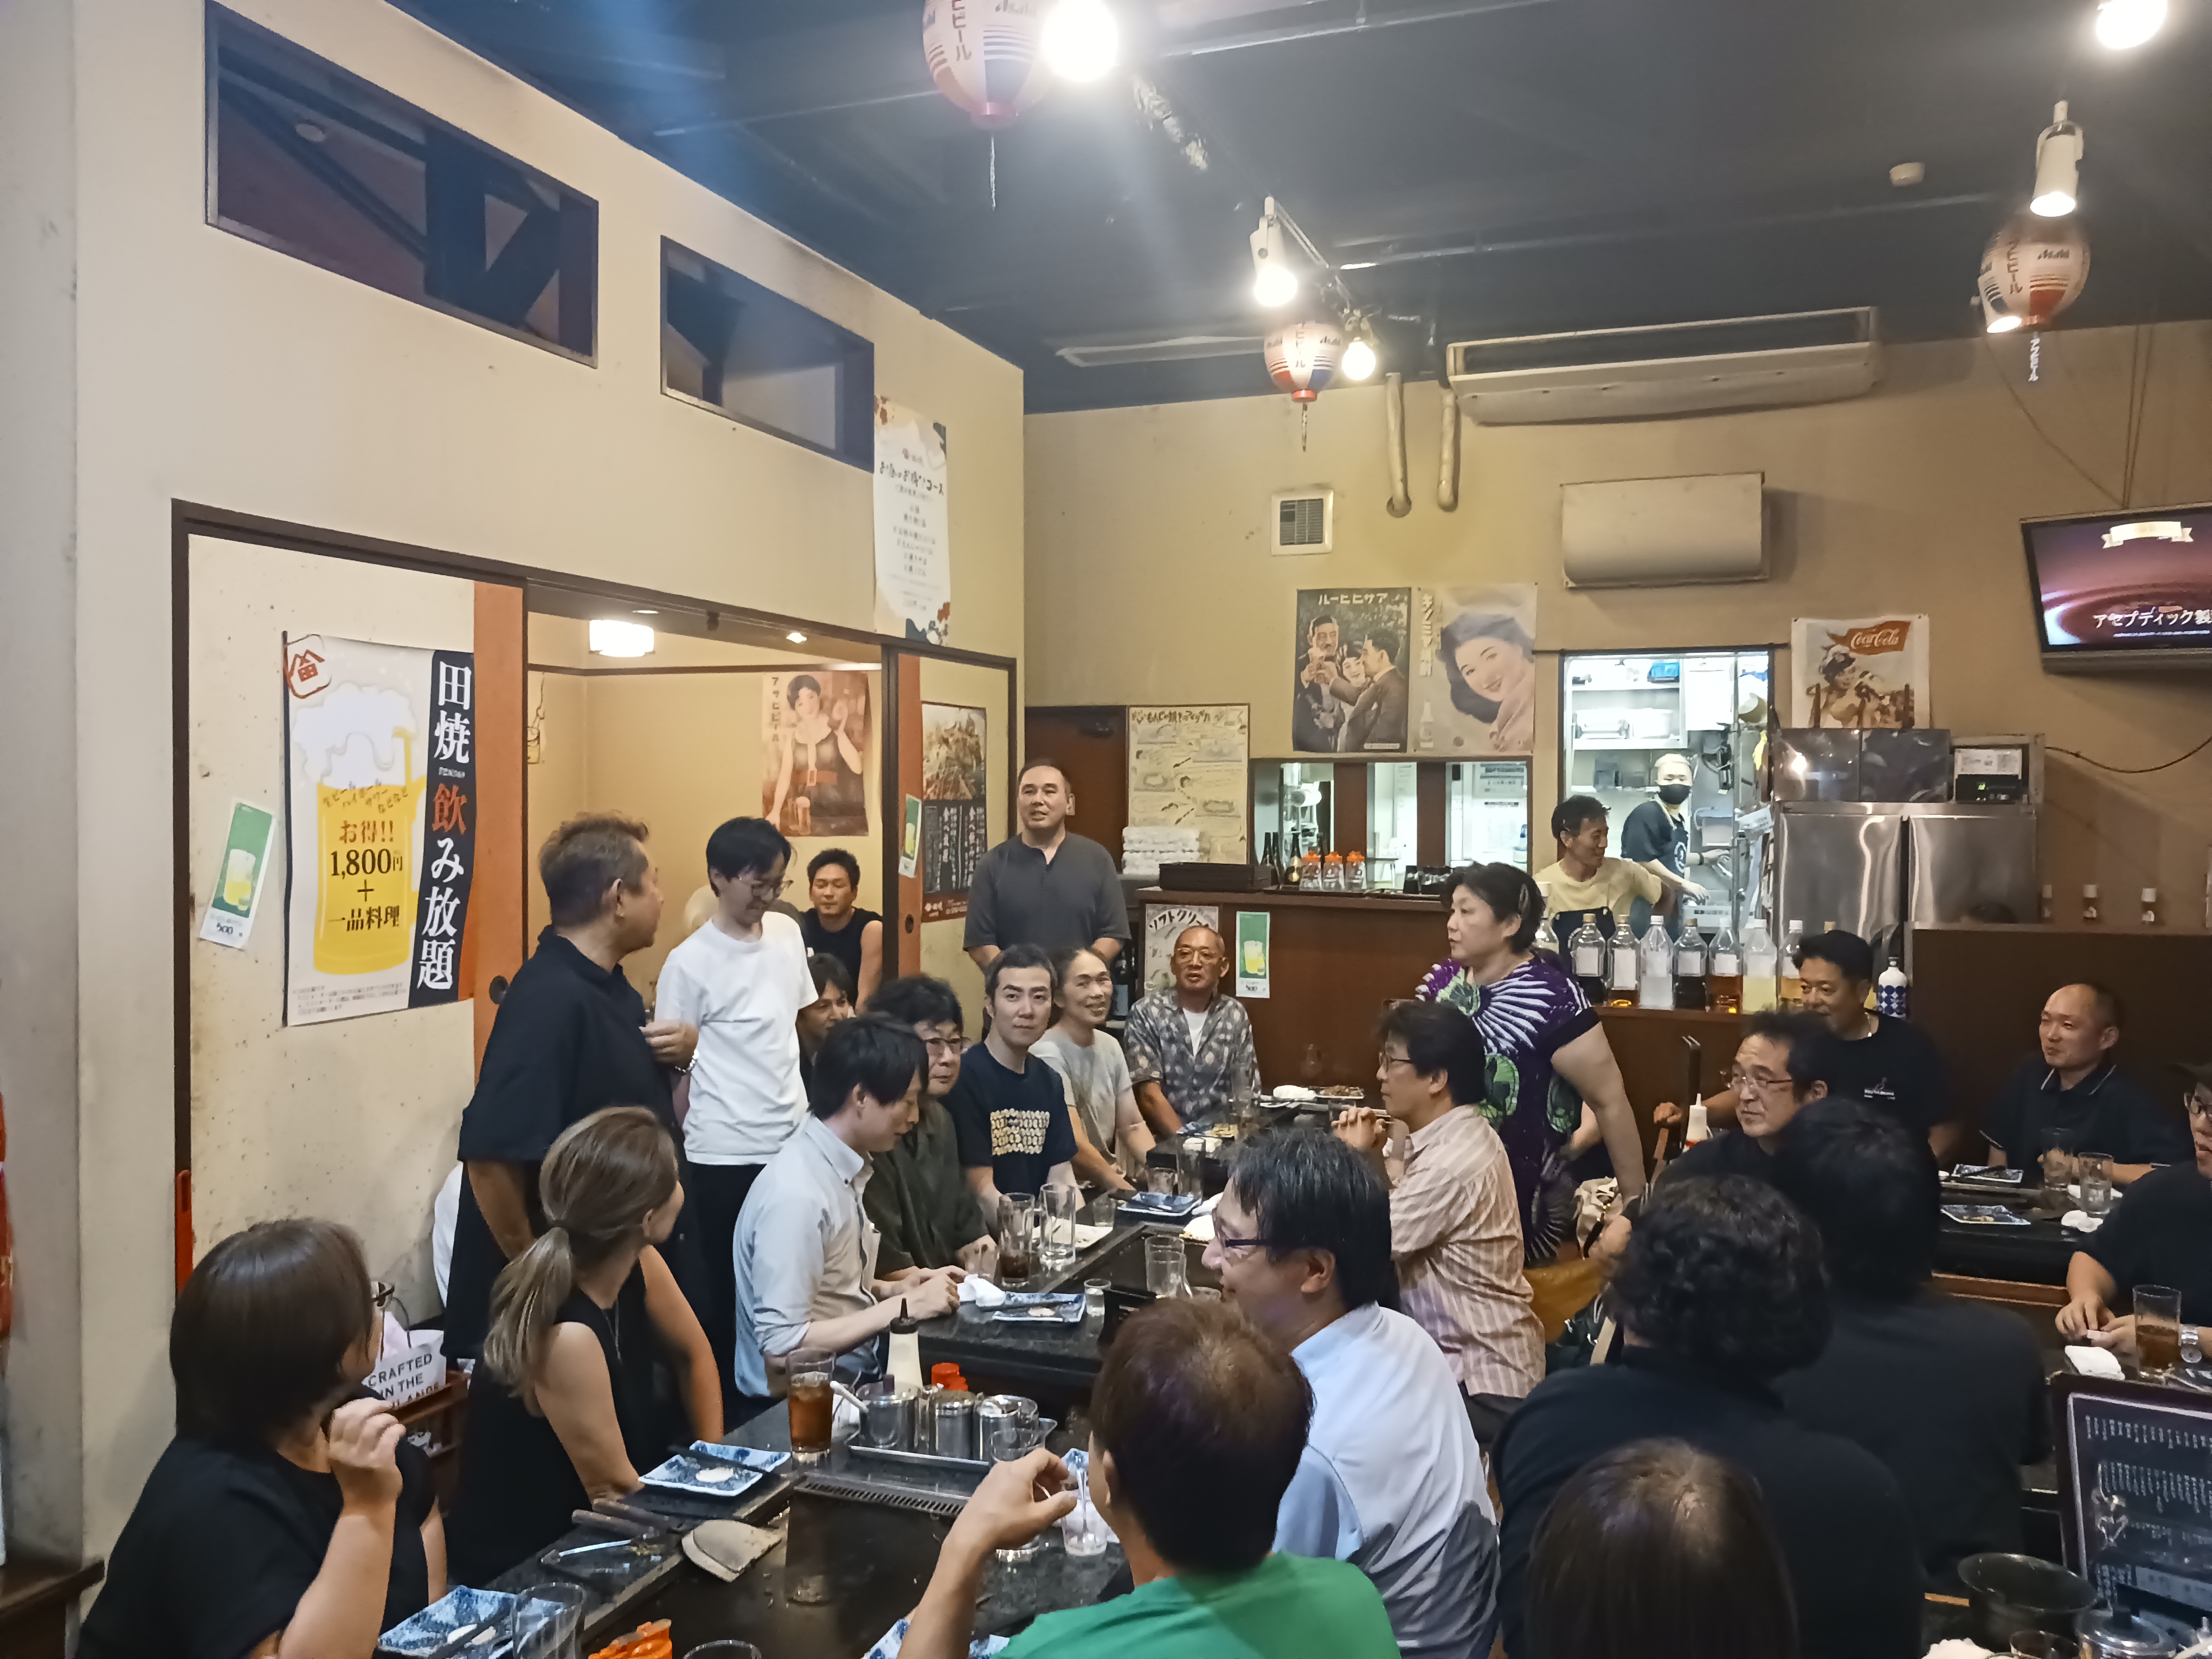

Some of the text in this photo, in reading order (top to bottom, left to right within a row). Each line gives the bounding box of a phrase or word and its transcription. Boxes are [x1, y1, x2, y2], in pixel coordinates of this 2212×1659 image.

[2093, 607, 2212, 629] アセプティック製
[328, 905, 400, 931] 一品料理
[1149, 909, 1209, 931] ソフトクリー
[368, 1353, 432, 1387] CRAFTED
[398, 1372, 423, 1392] THE
